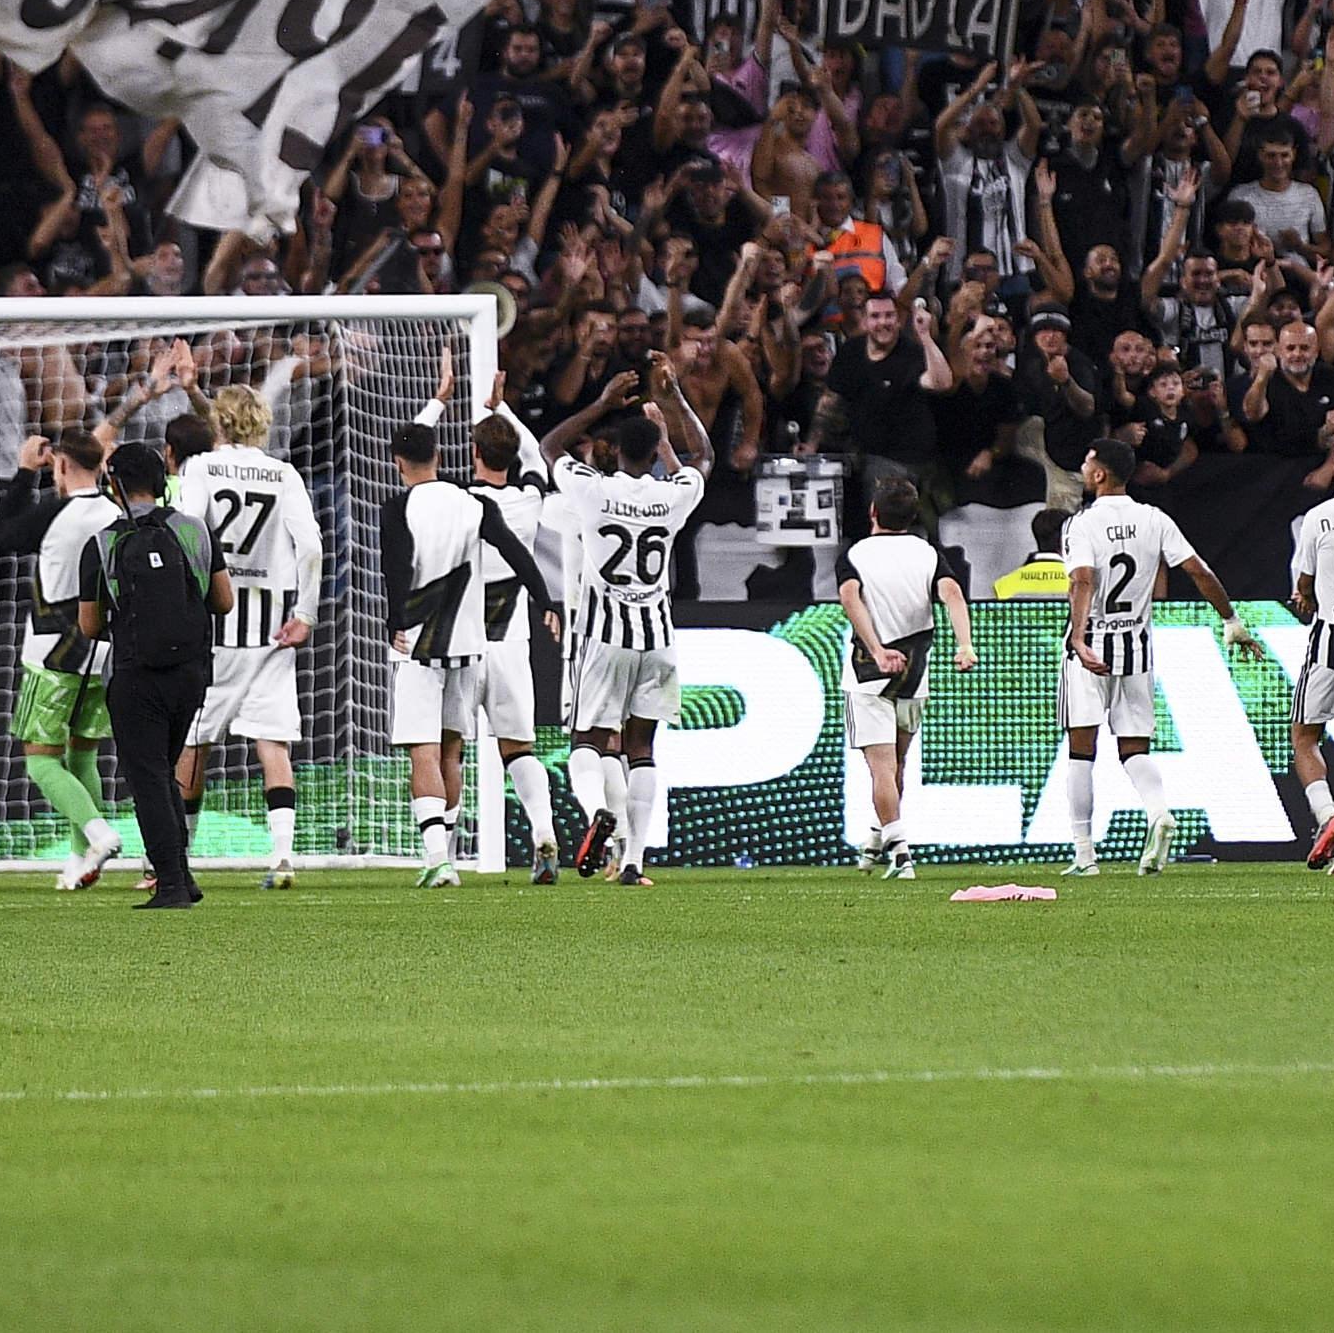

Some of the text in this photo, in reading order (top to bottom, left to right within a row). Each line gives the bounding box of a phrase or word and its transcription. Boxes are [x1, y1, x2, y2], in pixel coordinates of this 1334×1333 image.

[207, 463, 285, 484] WOLTEMADE
[213, 488, 278, 556] 27
[227, 565, 269, 579] games
[597, 524, 671, 587] 26
[1104, 551, 1138, 616] 2
